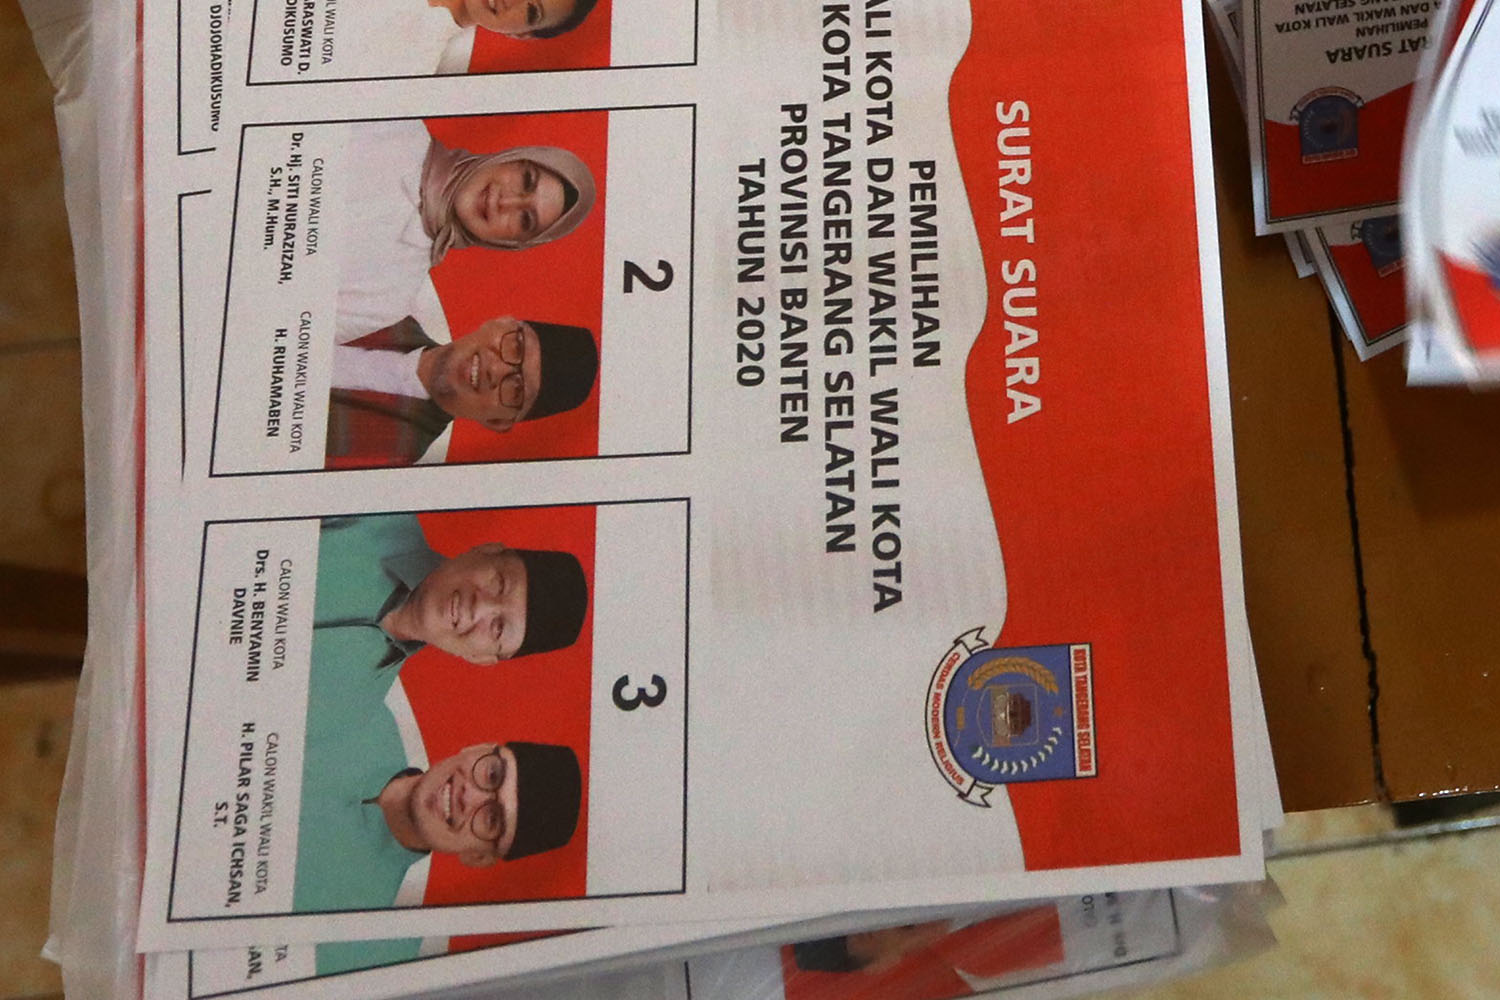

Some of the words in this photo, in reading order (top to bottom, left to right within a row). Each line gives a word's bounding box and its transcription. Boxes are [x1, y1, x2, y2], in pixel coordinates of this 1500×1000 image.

[324, 9, 337, 35] WALI
[1275, 19, 1311, 33] KOTA
[1315, 14, 1350, 28] WALI
[1355, 5, 1396, 21] WAKIL
[1355, 18, 1428, 38] PEMILIHAN
[1400, 2, 1429, 16] DAN
[298, 62, 310, 75] D.
[321, 38, 335, 64] KOTA
[823, 3, 851, 101] KOTA
[1325, 41, 1393, 64] SUARA
[866, 51, 894, 145] KOTA
[291, 132, 304, 150] Dr.
[267, 167, 282, 195] S.H.,
[287, 154, 302, 171] Hj.
[310, 158, 324, 195] CALON
[995, 100, 1035, 243] SURAT
[286, 175, 300, 199] SITI
[780, 103, 809, 274] PROVINSI
[867, 157, 895, 238] DAN
[264, 199, 280, 250] M.Hum.
[308, 197, 321, 225] WALI
[738, 158, 766, 282] TAHUN
[278, 203, 297, 285] NURAZIZAH,
[306, 228, 319, 256] KOTA
[823, 113, 854, 356] TANGERANG
[622, 259, 674, 294] 2
[909, 160, 941, 368] PEMILIHAN
[298, 311, 312, 350] CALON
[869, 251, 897, 376] WAKIL
[274, 329, 287, 343] H.
[737, 297, 765, 387] 2020
[1002, 259, 1042, 425] SUARA
[295, 352, 309, 388] WAKIL
[780, 287, 809, 443] BANTEN
[266, 346, 286, 437] RUHAMABEN
[292, 391, 306, 420] WALI
[289, 423, 304, 453] KOTA
[870, 388, 900, 488] WALI
[824, 370, 856, 553] SELATAN
[254, 549, 270, 579] Drs.
[872, 503, 903, 612] KOTA
[252, 582, 267, 598] H.
[278, 559, 292, 601] CALON
[229, 588, 246, 645] DAVNIE
[275, 603, 289, 635] WALI
[246, 601, 265, 682] BENYAMIN
[272, 638, 286, 670] KOTA
[1074, 649, 1086, 672] KOTA
[936, 652, 960, 691] CERDAS
[612, 673, 667, 712] 3
[1076, 675, 1089, 730] TANGERANG
[241, 722, 255, 738] H.
[932, 692, 941, 738] MODERN
[237, 743, 254, 788] PILAR
[264, 733, 279, 776] CALON
[935, 742, 964, 785] RELIGIUS
[1078, 732, 1091, 771] SELATAN
[213, 802, 228, 828] S.T.
[233, 792, 250, 837] SAGA
[260, 780, 276, 820] WAKIL
[257, 823, 272, 856] WALI
[226, 842, 246, 908] ICHSAN,
[255, 860, 270, 894] KOTA
